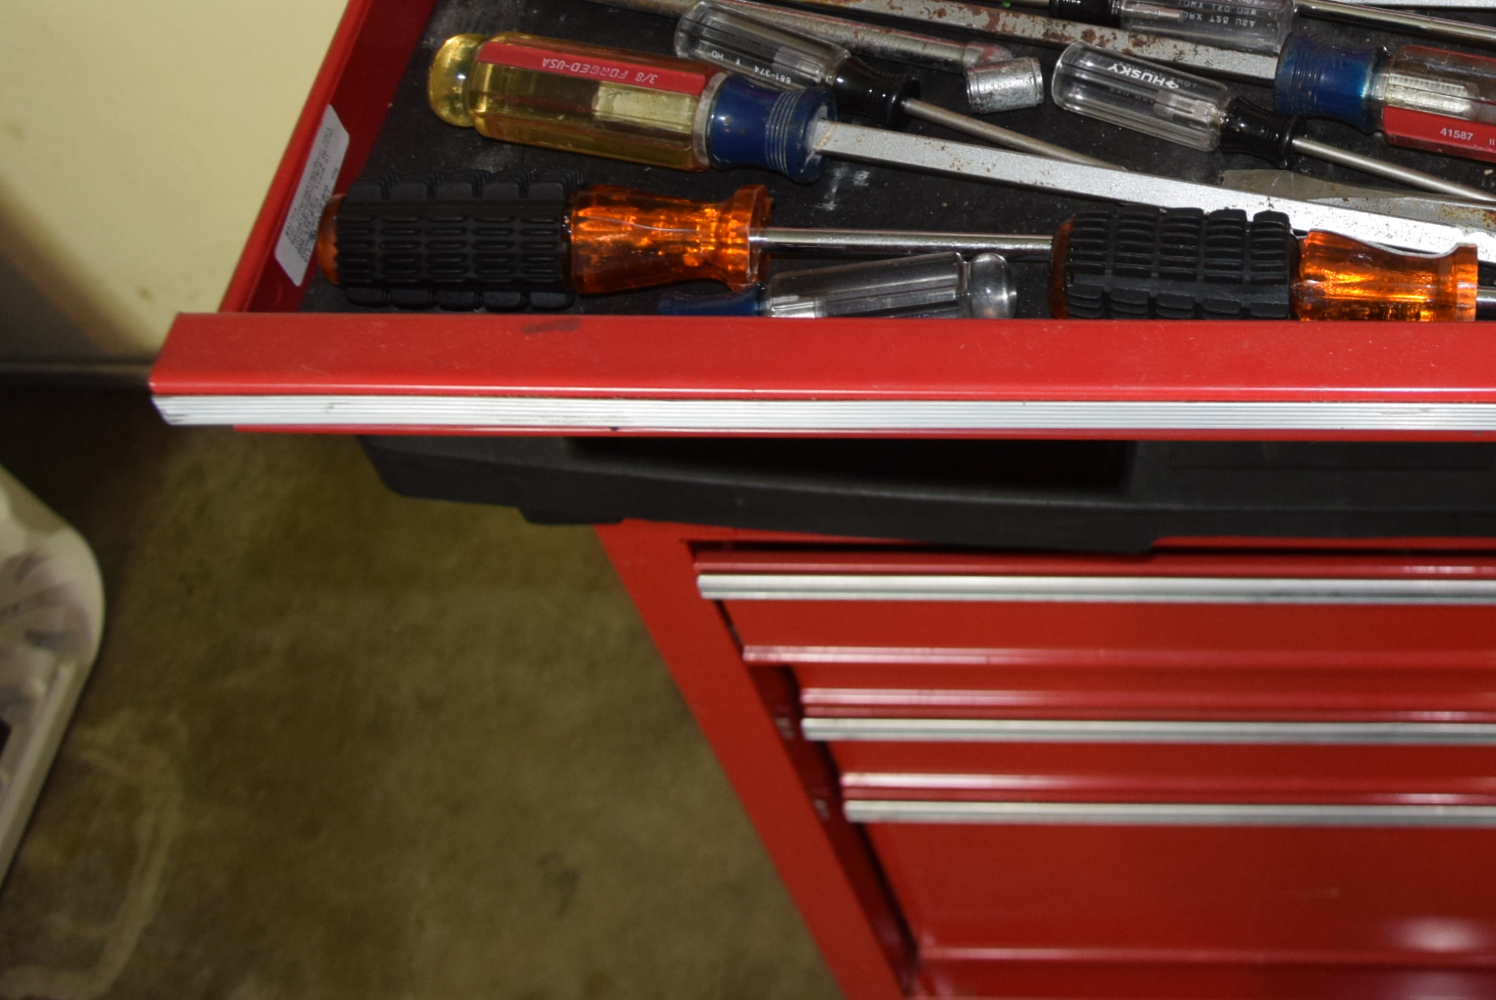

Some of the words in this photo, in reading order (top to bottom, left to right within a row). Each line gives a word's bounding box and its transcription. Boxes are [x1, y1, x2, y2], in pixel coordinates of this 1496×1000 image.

[541, 57, 630, 80] FORGED-USA
[635, 71, 659, 85] 3/8
[754, 65, 792, 85] 681-374
[1107, 62, 1166, 86] HUSKY
[1440, 127, 1474, 141] 41587
